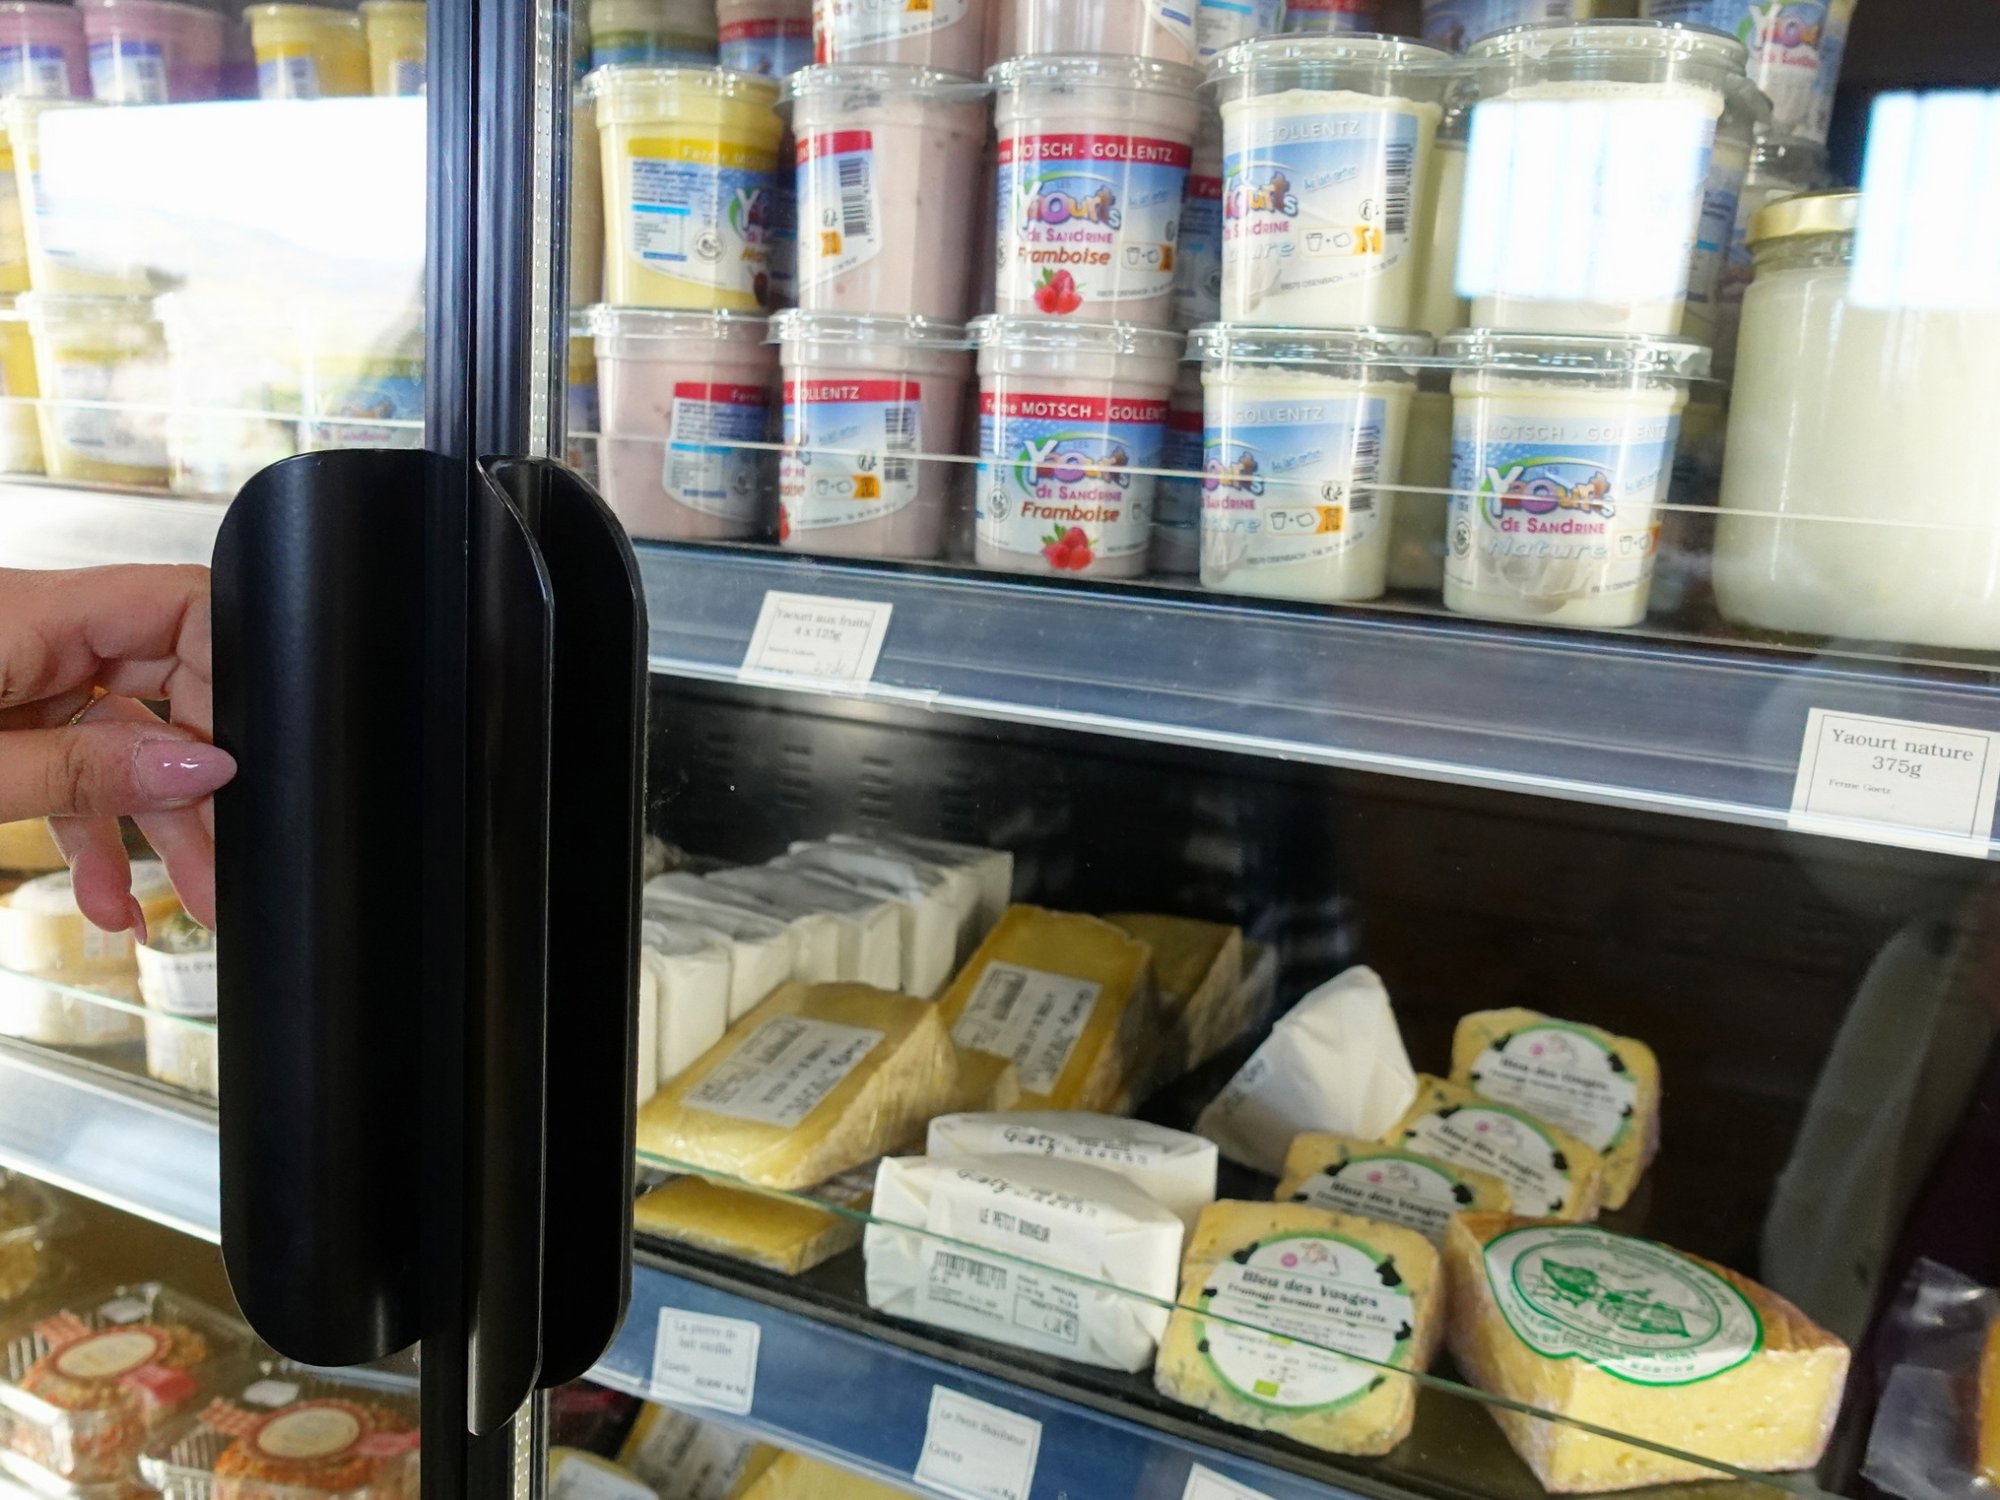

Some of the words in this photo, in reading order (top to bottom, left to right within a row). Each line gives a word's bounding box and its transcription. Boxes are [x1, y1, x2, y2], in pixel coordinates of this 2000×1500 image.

[1092, 142, 1173, 162] GOLLENTZ
[1022, 401, 1092, 418] MOTSCH
[1020, 501, 1121, 523] Framboise
[1832, 728, 1897, 751] Yaourt
[1904, 739, 1974, 762] nature
[1872, 755, 1924, 779] 375g
[1828, 778, 1860, 791] Ferme
[979, 1207, 990, 1224] LE
[1241, 1269, 1279, 1288] Bleu
[1284, 1278, 1314, 1295] des
[1320, 1284, 1379, 1309] Vosges
